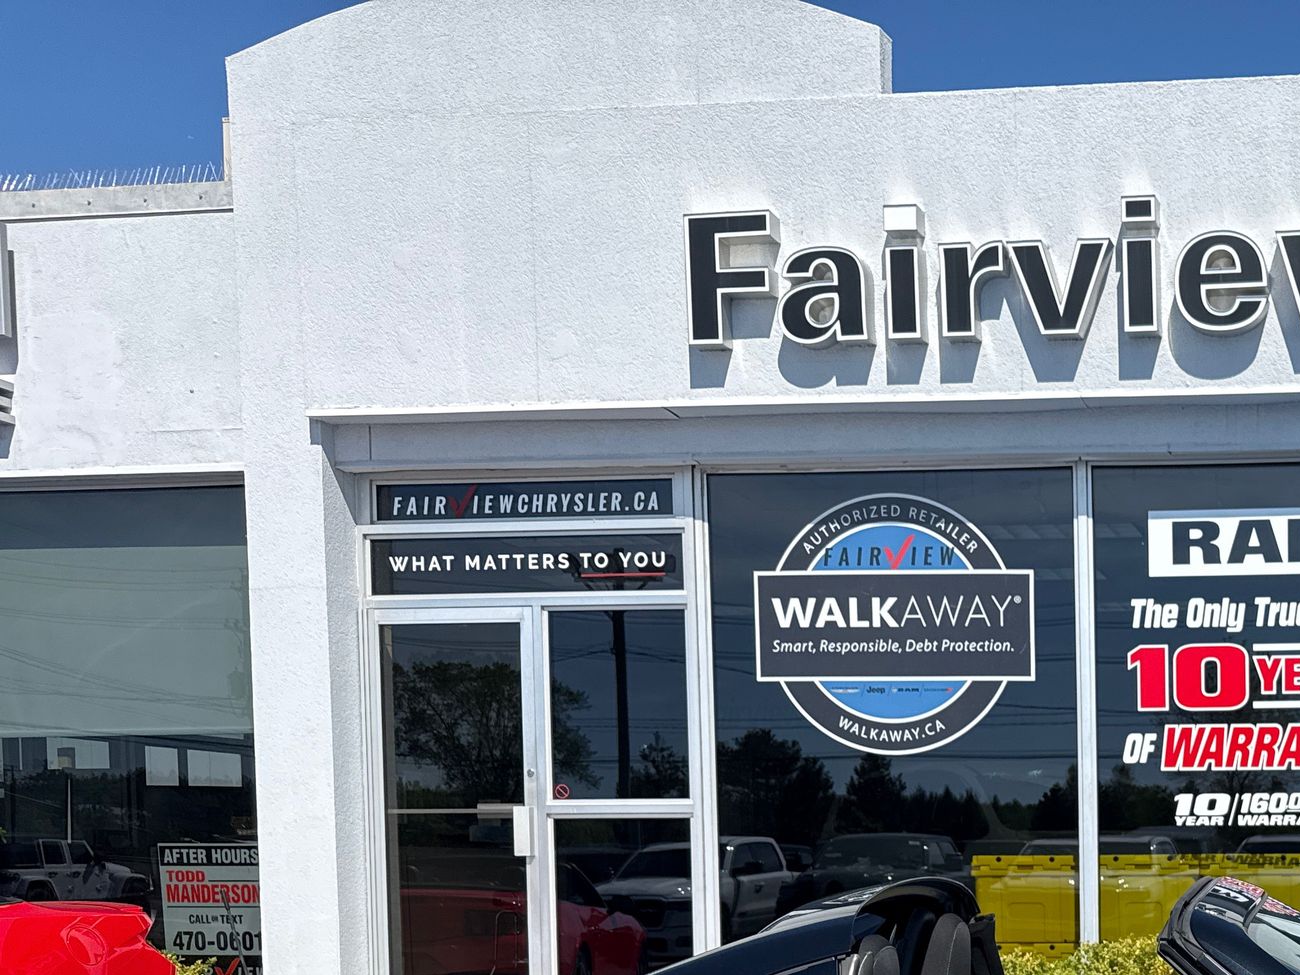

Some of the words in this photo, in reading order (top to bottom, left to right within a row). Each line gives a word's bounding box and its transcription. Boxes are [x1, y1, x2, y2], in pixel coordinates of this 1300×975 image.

[803, 504, 900, 555] AUTHORIZED
[908, 507, 979, 554] RETAILER
[389, 555, 454, 572] WHAT
[465, 553, 570, 570] MATTERS
[580, 552, 609, 569] TO
[619, 551, 667, 568] YOU
[1130, 598, 1180, 629] The
[1186, 597, 1246, 633] Only
[772, 640, 816, 655] Smart,
[820, 639, 902, 655] Responsible,
[906, 639, 937, 652] Debt
[941, 639, 1015, 652] Protection.
[1127, 643, 1250, 712] 10
[838, 715, 946, 743] WALKAWAY.CA
[1122, 732, 1158, 764] OF
[1174, 793, 1231, 816] 10
[1174, 815, 1225, 826] YEAR
[164, 848, 207, 864] AFTER
[211, 848, 259, 864] HOURS
[166, 870, 206, 883] TODD
[166, 884, 260, 904] MANDERSON
[189, 914, 211, 925] CALL
[220, 914, 244, 925] TEXT
